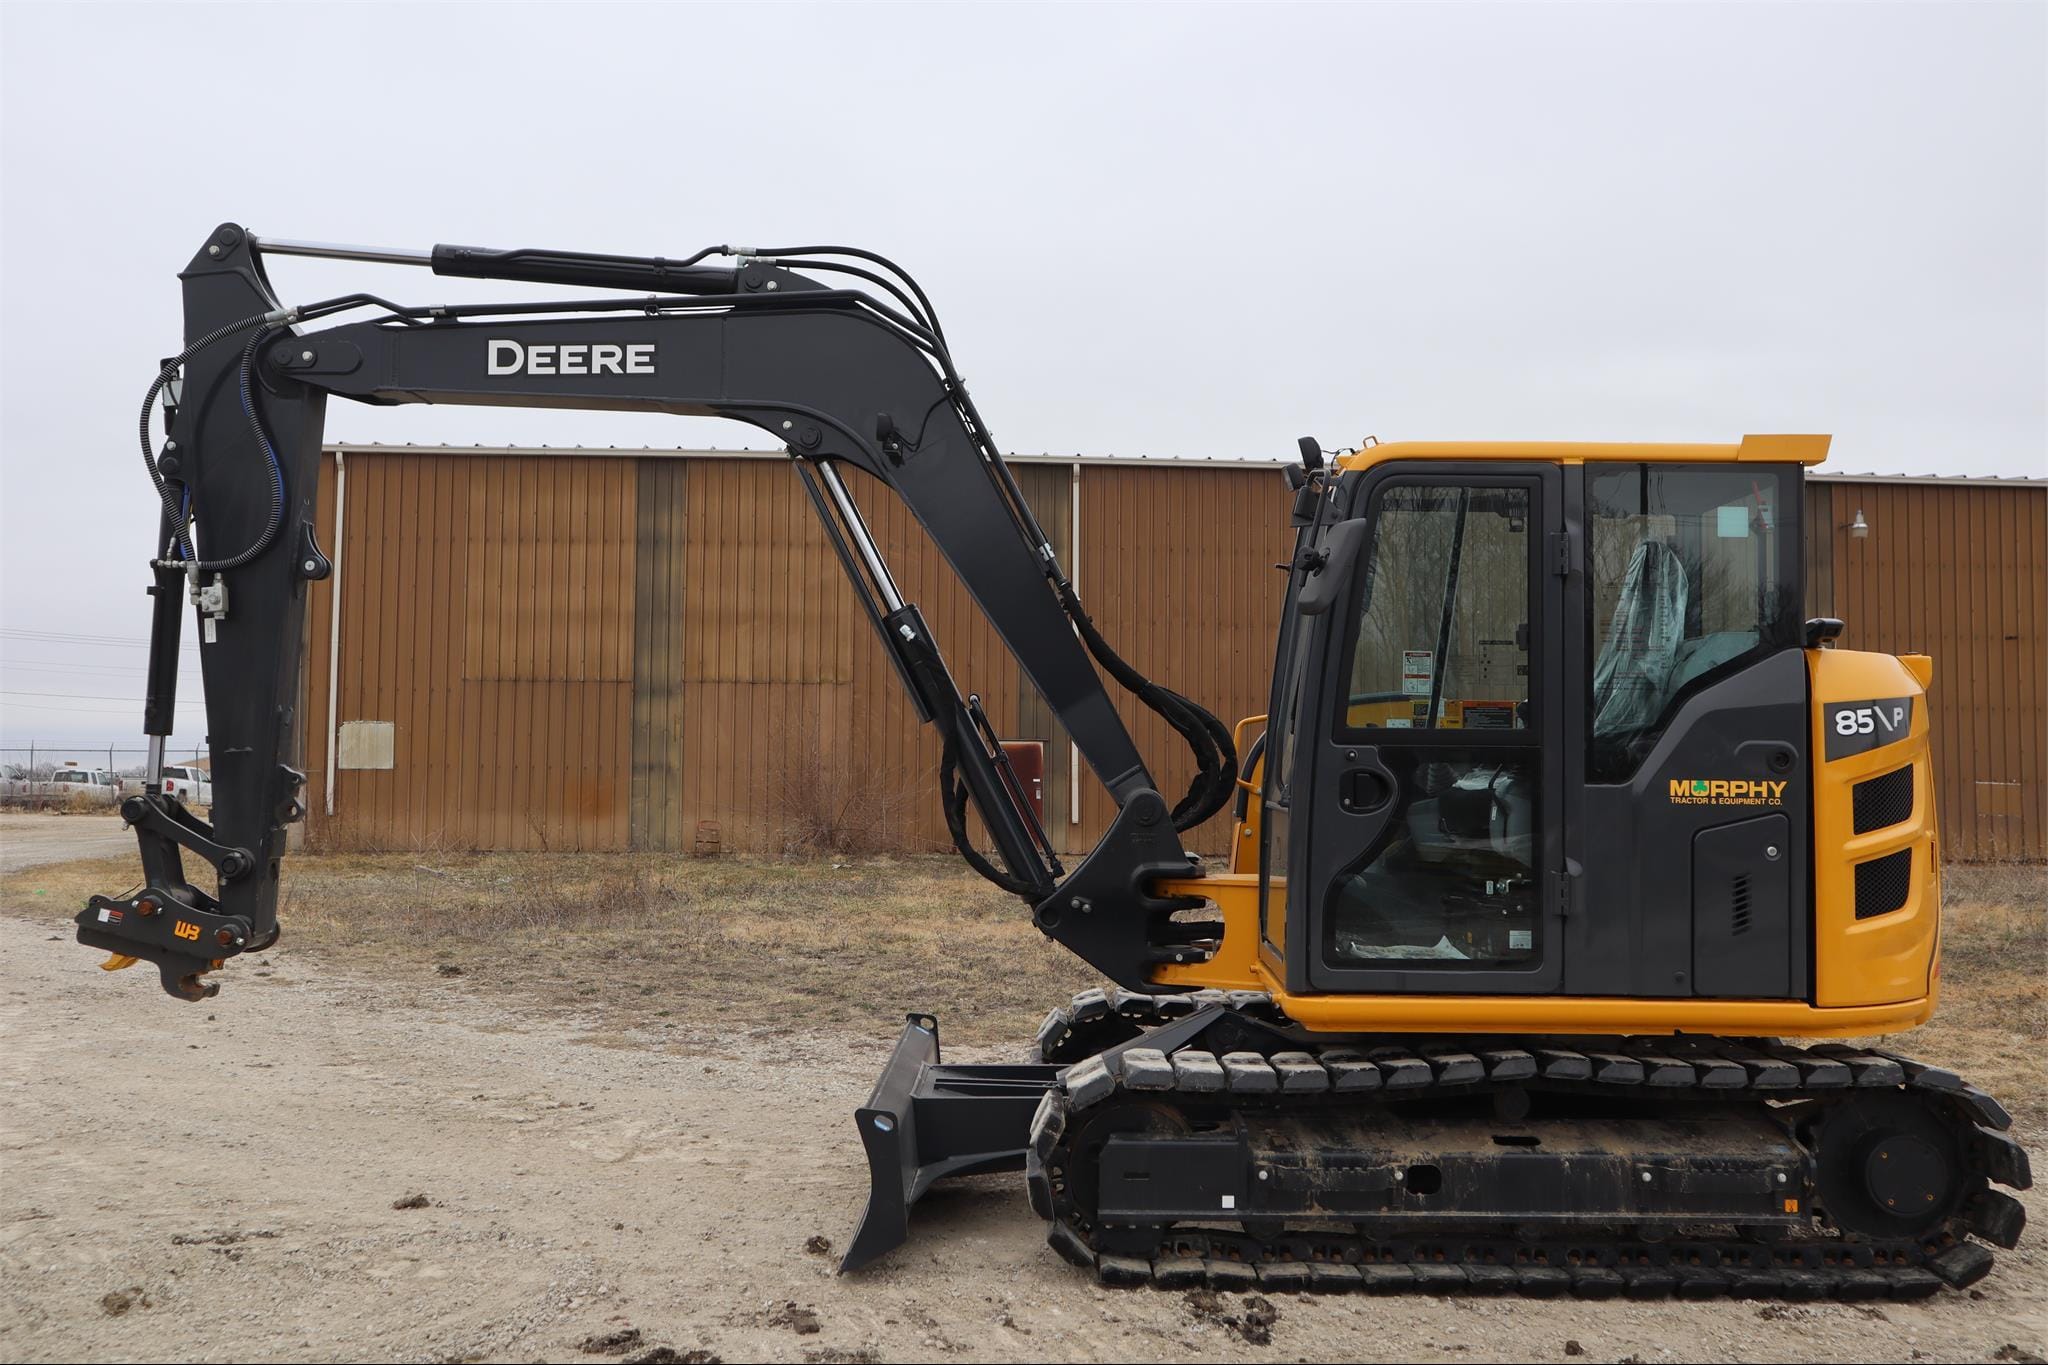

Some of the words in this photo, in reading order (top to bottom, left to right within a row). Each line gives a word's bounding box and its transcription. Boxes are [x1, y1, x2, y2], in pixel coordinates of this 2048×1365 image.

[488, 340, 655, 375] DEERE
[1669, 780, 1787, 797] MURPHY
[1671, 797, 1709, 805] TRACTOR
[1711, 797, 1717, 805] &
[1718, 797, 1766, 805] EQUIPMENT
